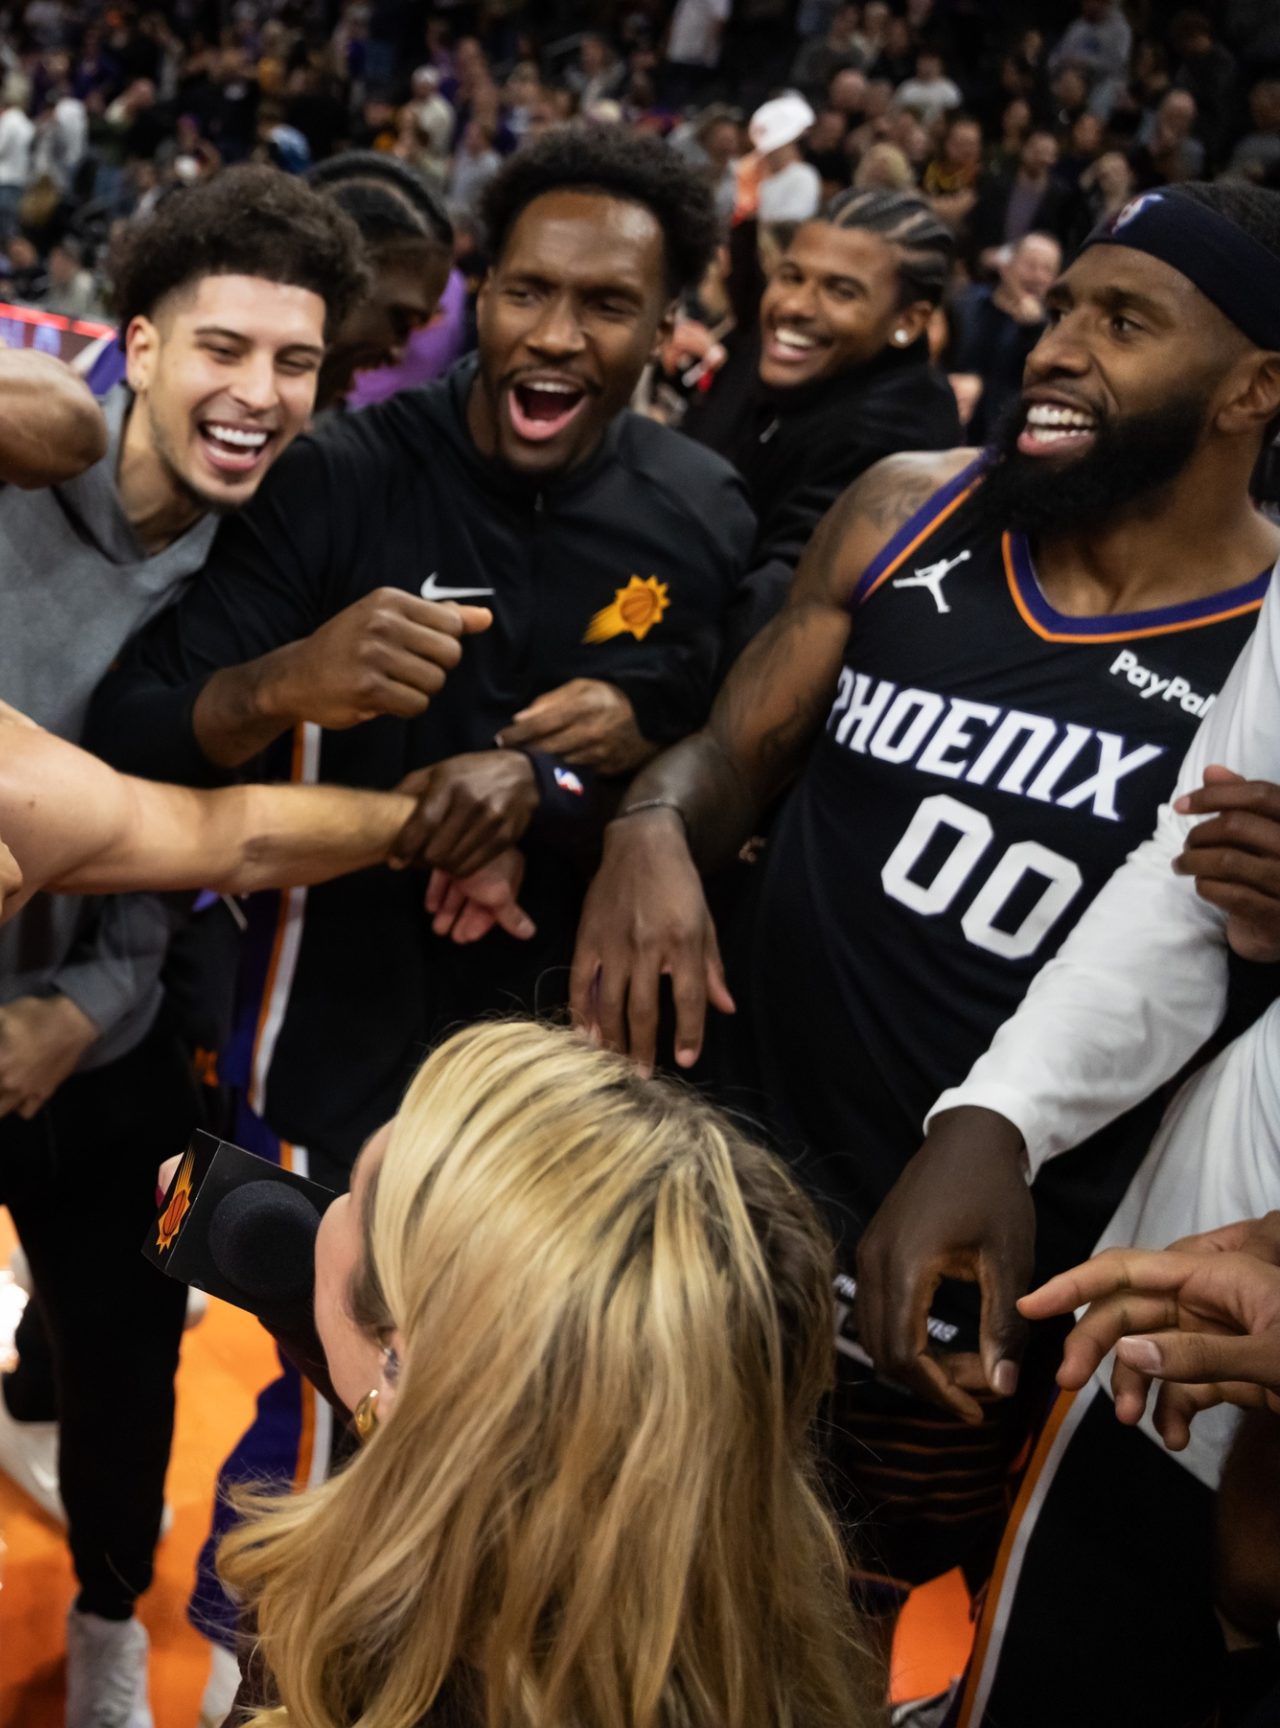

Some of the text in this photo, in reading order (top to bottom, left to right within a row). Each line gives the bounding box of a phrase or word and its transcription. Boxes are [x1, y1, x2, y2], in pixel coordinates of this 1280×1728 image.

[826, 665, 1168, 821] PHOENIX
[1109, 649, 1216, 718] PayPal
[880, 794, 1083, 961] 00
